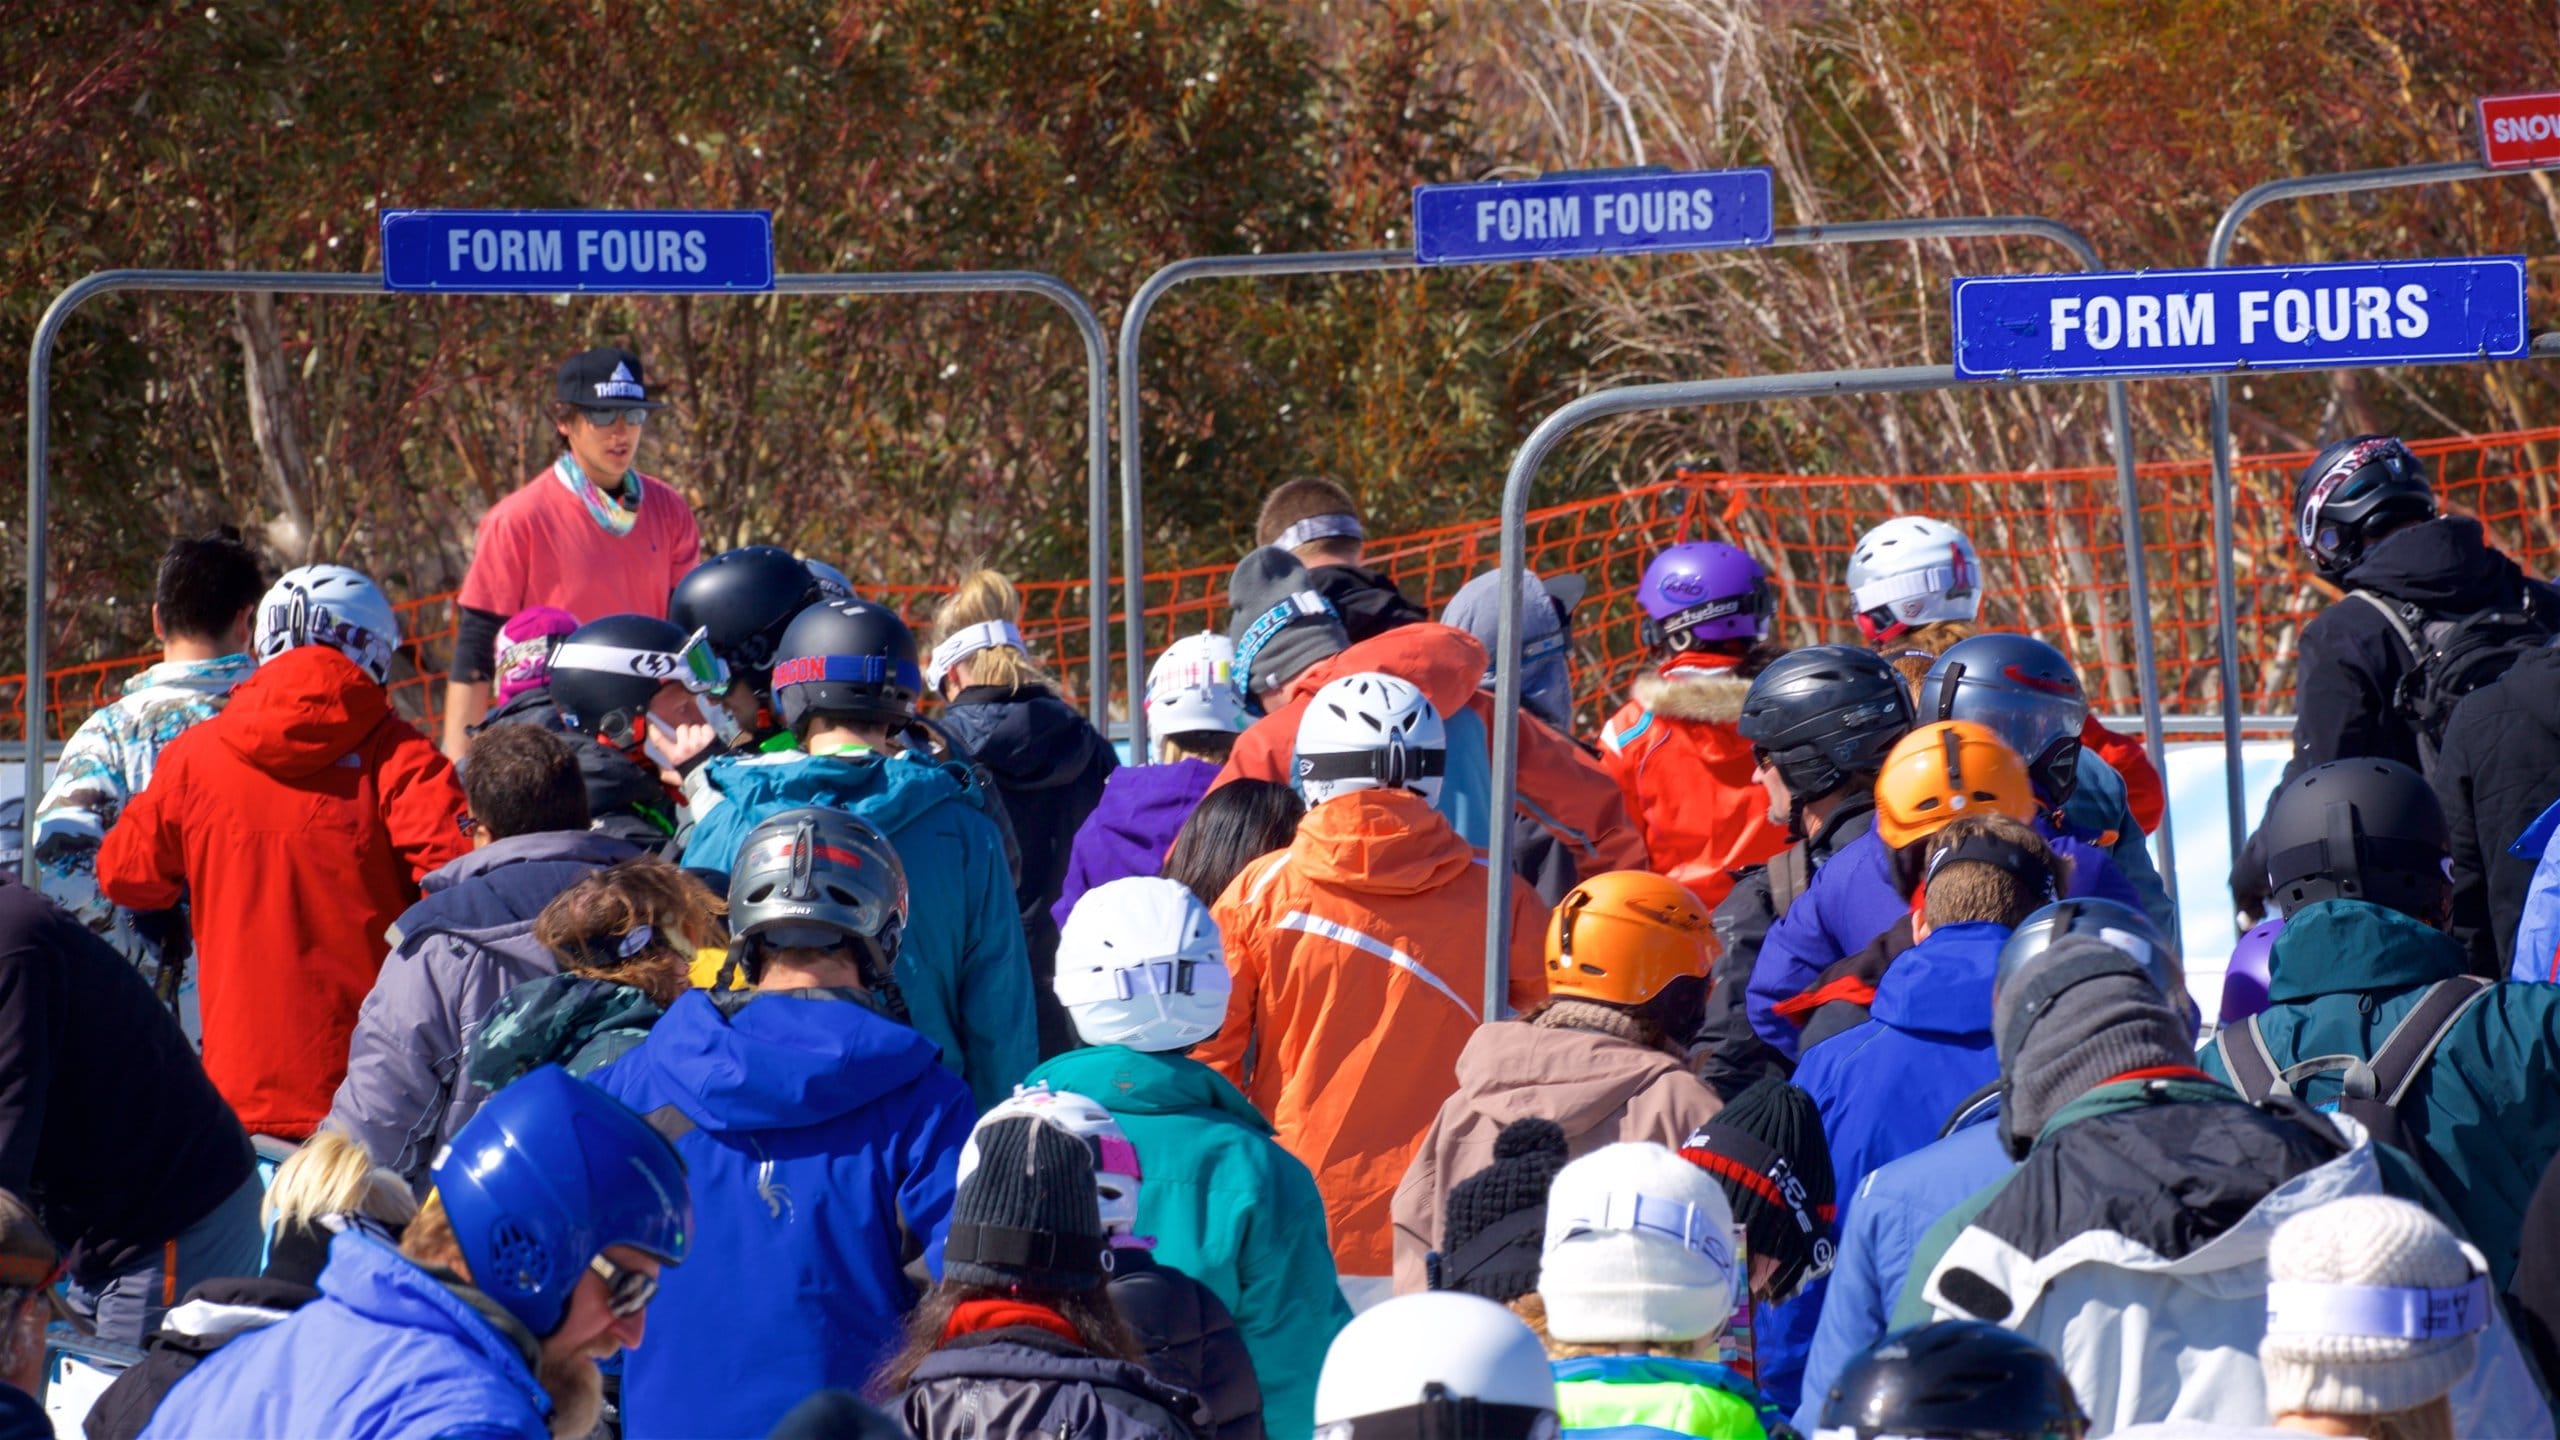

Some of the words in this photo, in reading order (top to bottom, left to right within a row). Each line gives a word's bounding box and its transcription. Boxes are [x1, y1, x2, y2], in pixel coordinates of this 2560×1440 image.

[1476, 196, 1581, 243] FORM
[1593, 188, 1714, 236] FOURS
[447, 229, 563, 272] FORM
[577, 229, 708, 273] FOURS
[2050, 292, 2216, 352] FORM
[2238, 283, 2430, 345] FOURS
